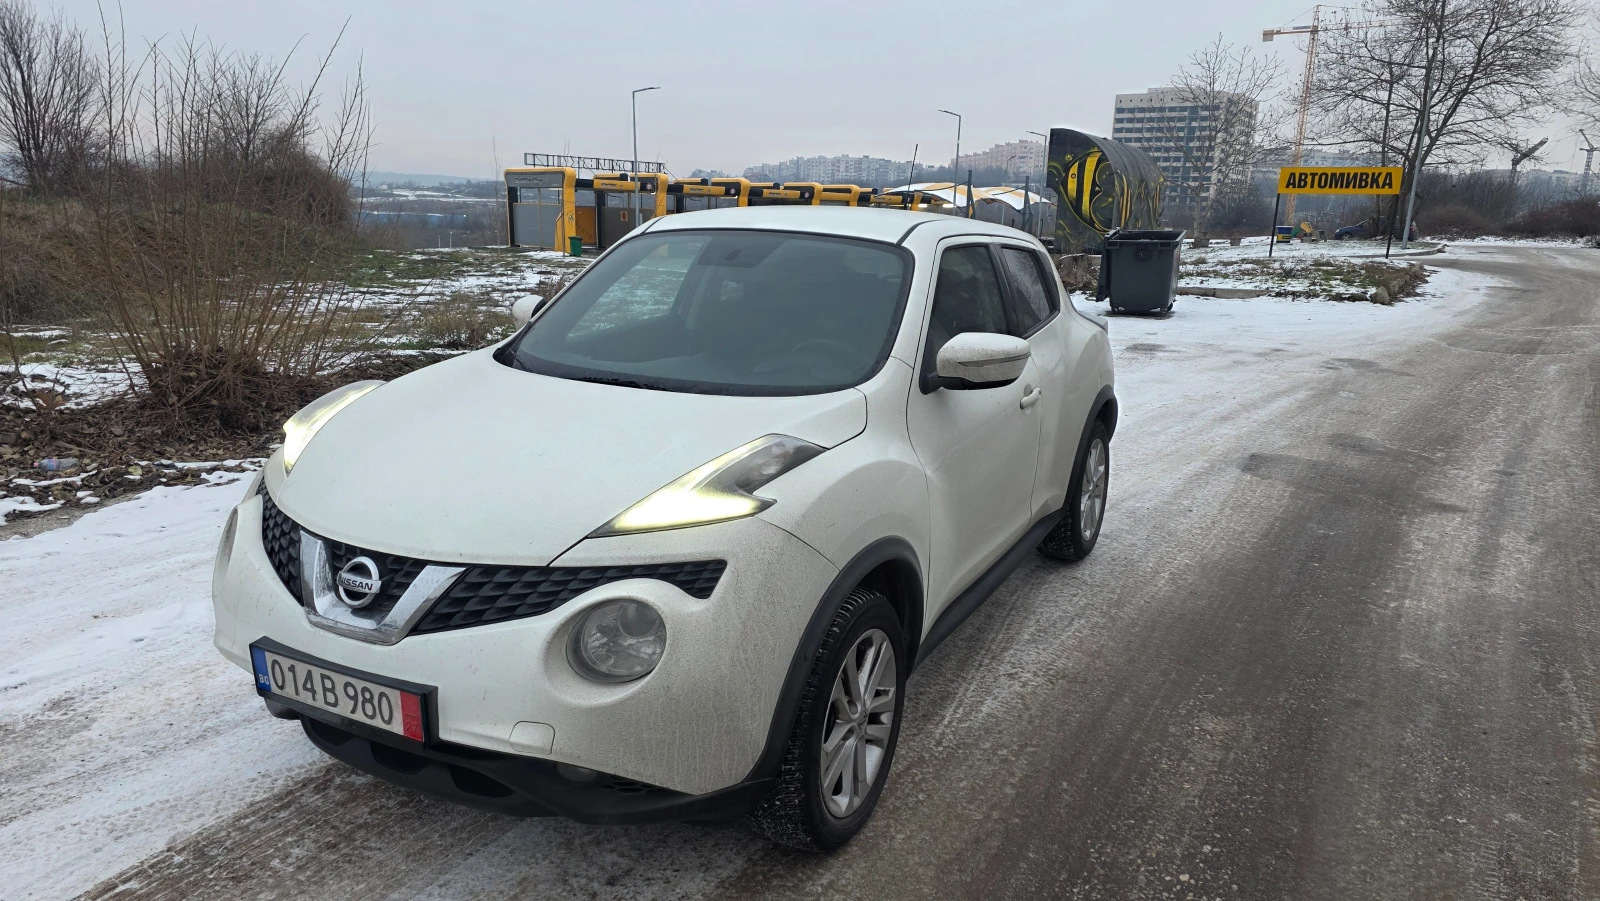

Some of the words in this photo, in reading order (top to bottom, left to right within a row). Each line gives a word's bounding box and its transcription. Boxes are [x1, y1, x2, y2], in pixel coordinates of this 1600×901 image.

[1285, 172, 1393, 189] АВТОМИВКА
[339, 575, 374, 591] NISSAN
[259, 673, 270, 685] BG
[271, 659, 393, 725] 014B980
